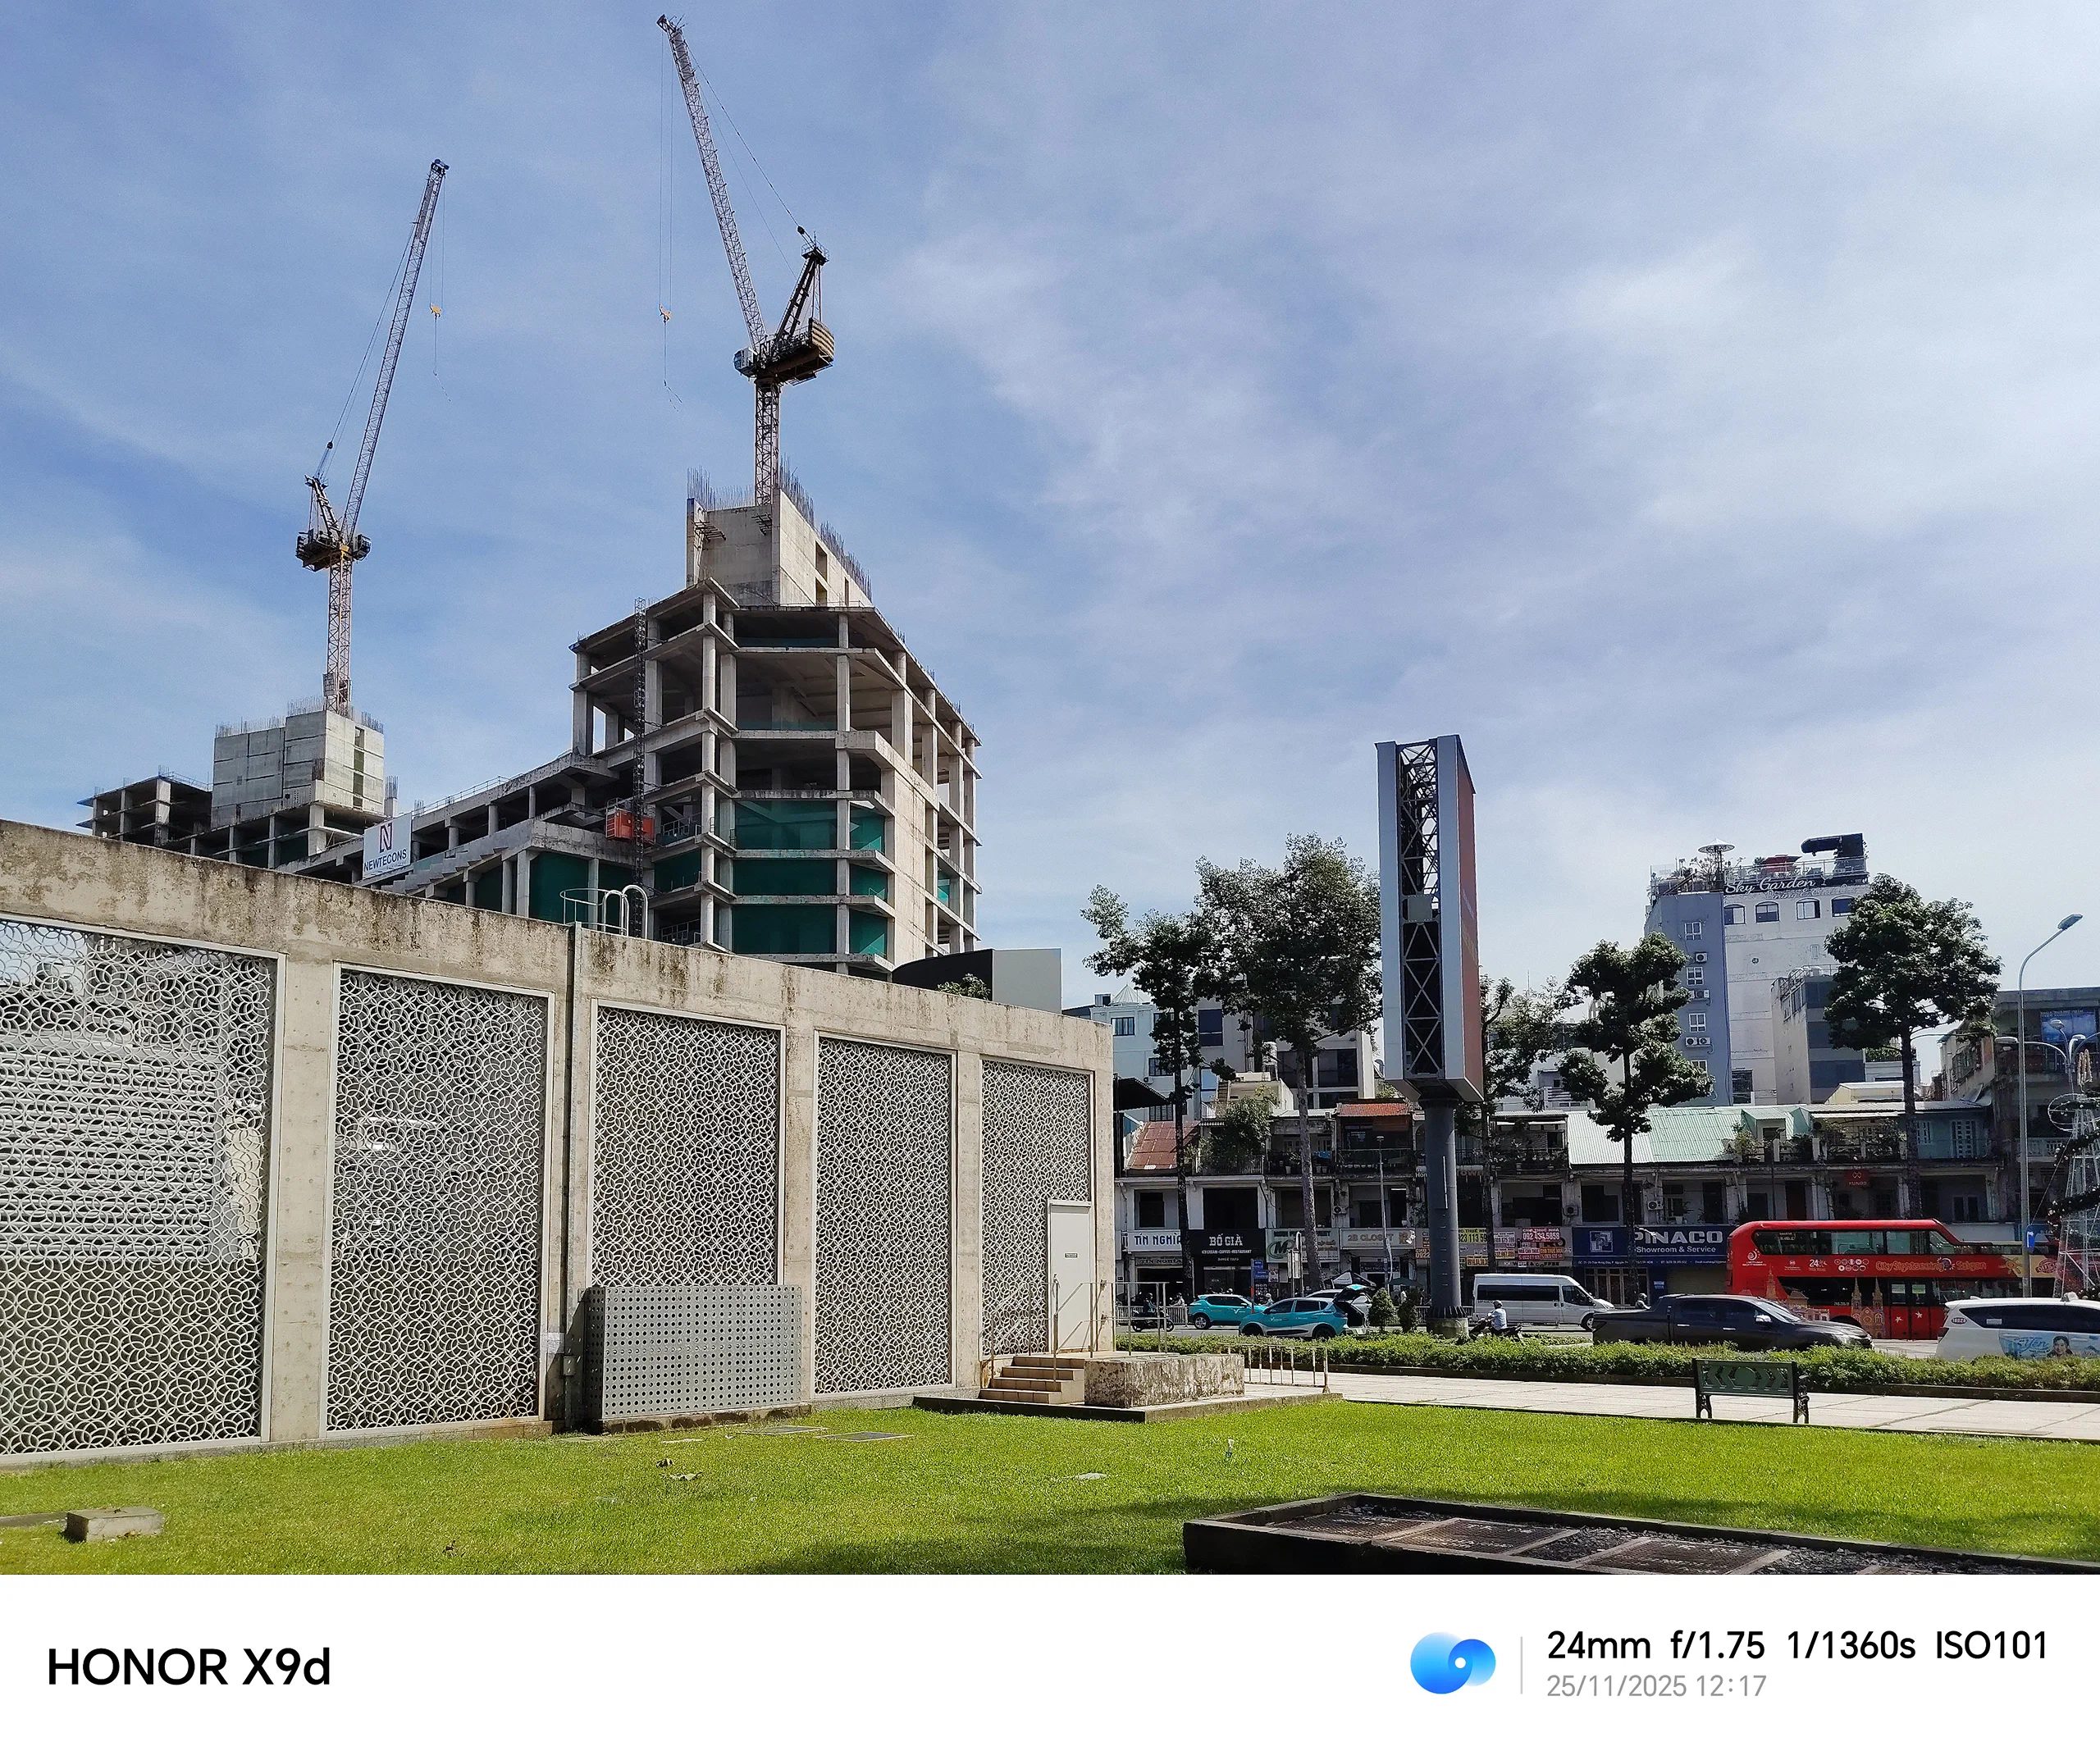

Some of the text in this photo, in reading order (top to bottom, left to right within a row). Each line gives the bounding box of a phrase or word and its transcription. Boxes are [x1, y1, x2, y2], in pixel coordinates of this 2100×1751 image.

[363, 849, 407, 872] NEWTECONS
[1725, 882, 1755, 895] Sky
[1759, 877, 1815, 891] Garden
[1134, 1233, 1148, 1245] TÍN
[1209, 1233, 1243, 1246] BỐ GIÀ
[1635, 1231, 1723, 1243] PINACO
[1956, 1261, 1987, 1271] Saigon
